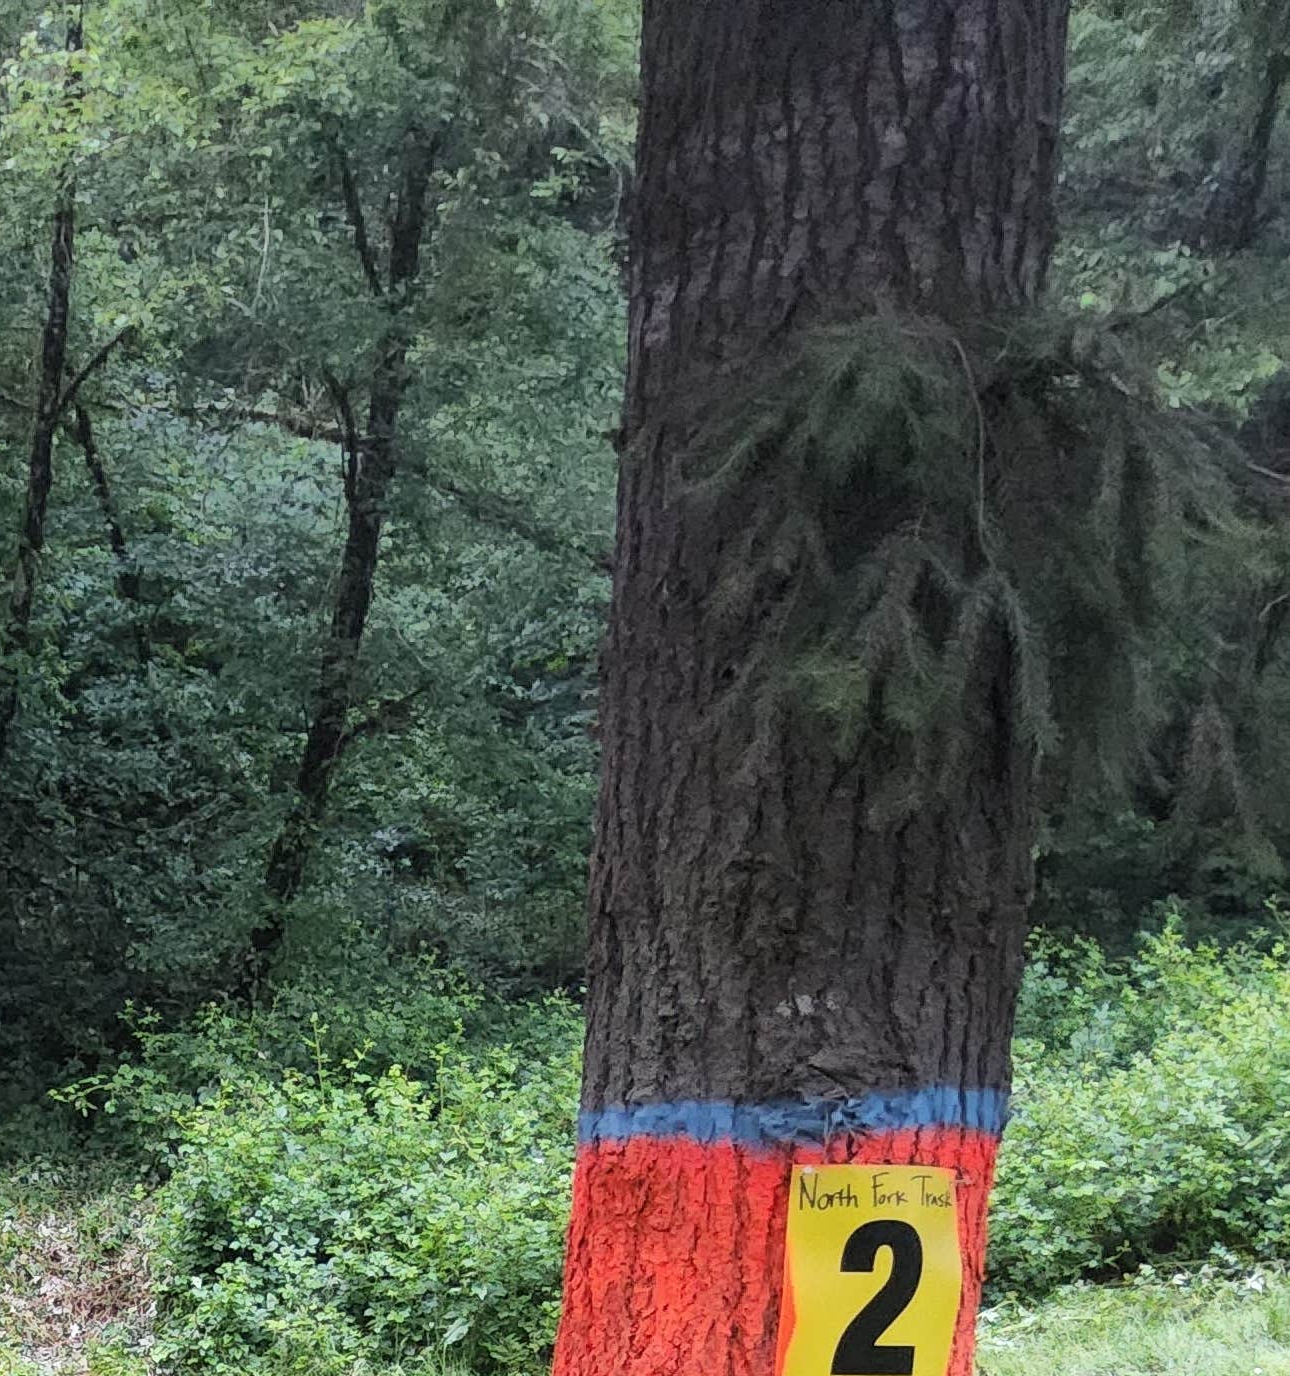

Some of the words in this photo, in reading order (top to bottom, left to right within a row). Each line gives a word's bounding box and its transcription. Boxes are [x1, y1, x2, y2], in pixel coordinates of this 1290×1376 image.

[799, 1172, 859, 1210] North
[871, 1171, 908, 1208] Fork
[910, 1174, 953, 1208] Trask
[829, 1219, 924, 1376] 2
